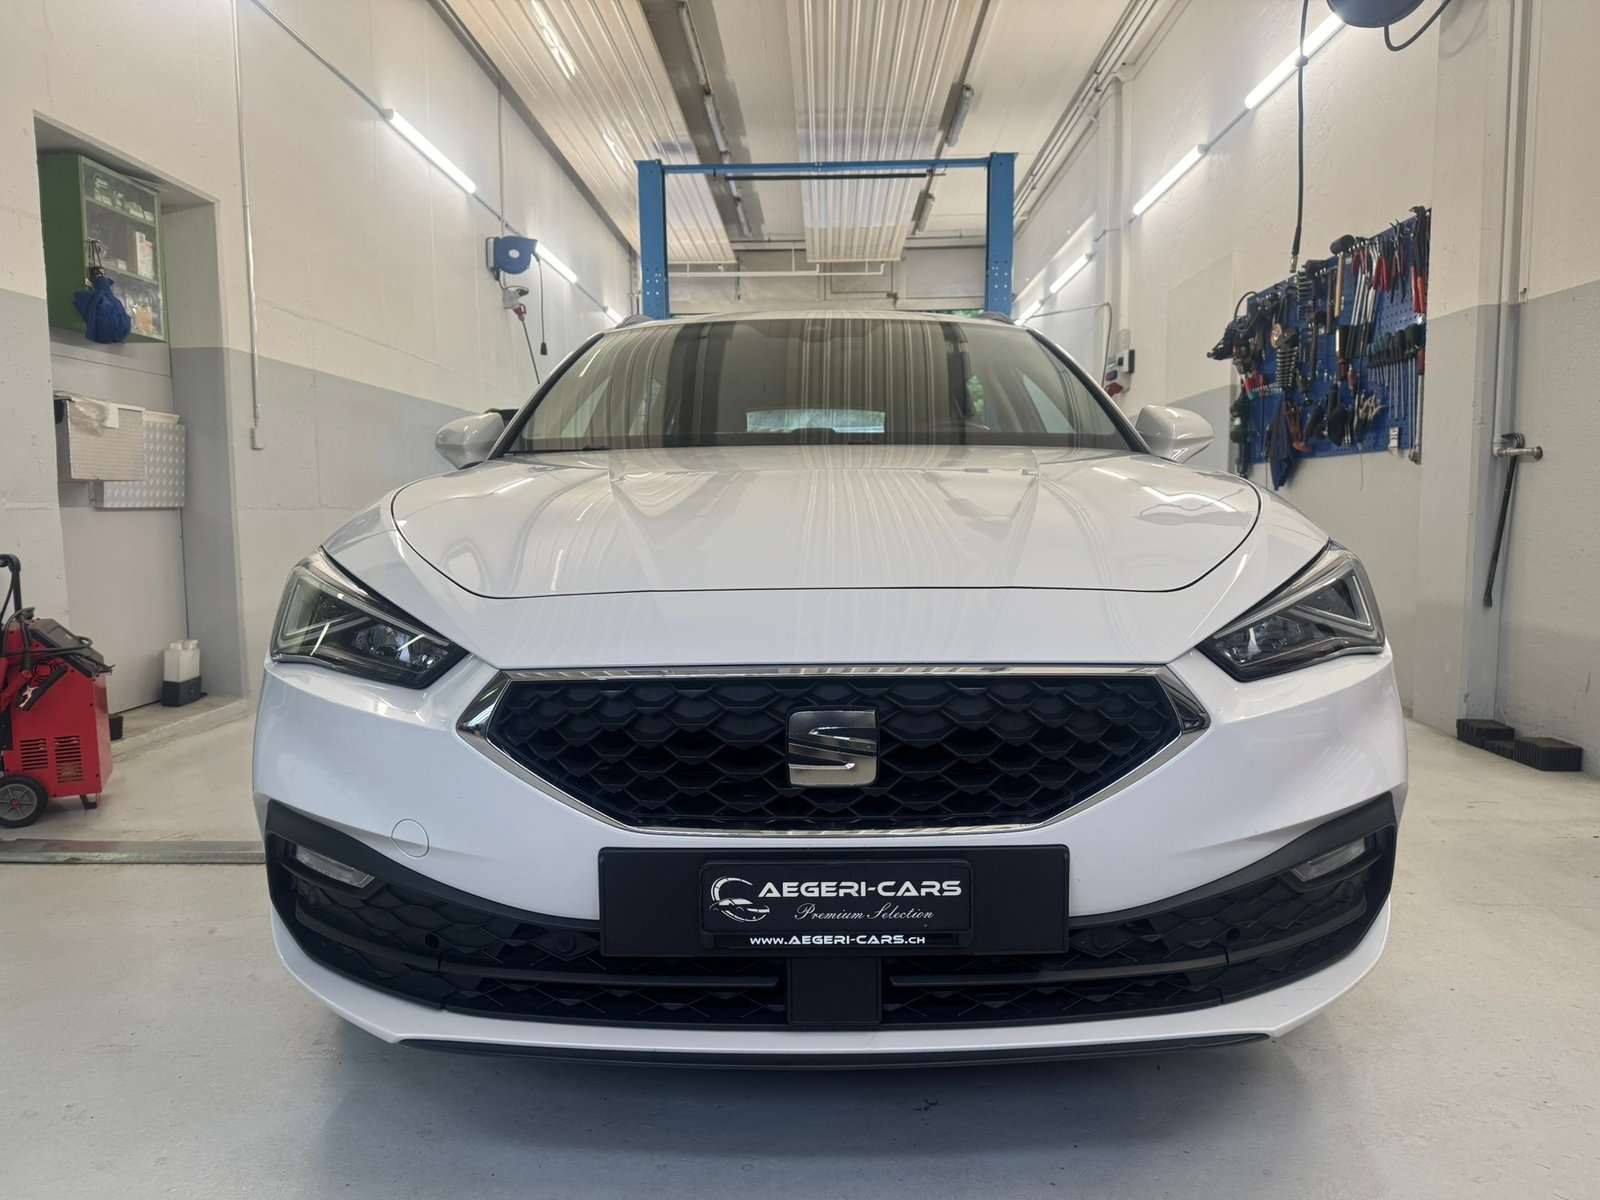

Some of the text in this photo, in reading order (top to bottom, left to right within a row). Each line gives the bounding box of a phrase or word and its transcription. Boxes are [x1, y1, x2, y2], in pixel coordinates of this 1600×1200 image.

[758, 880, 963, 898] AEGERI-CARS
[794, 902, 934, 921] Premium Selection
